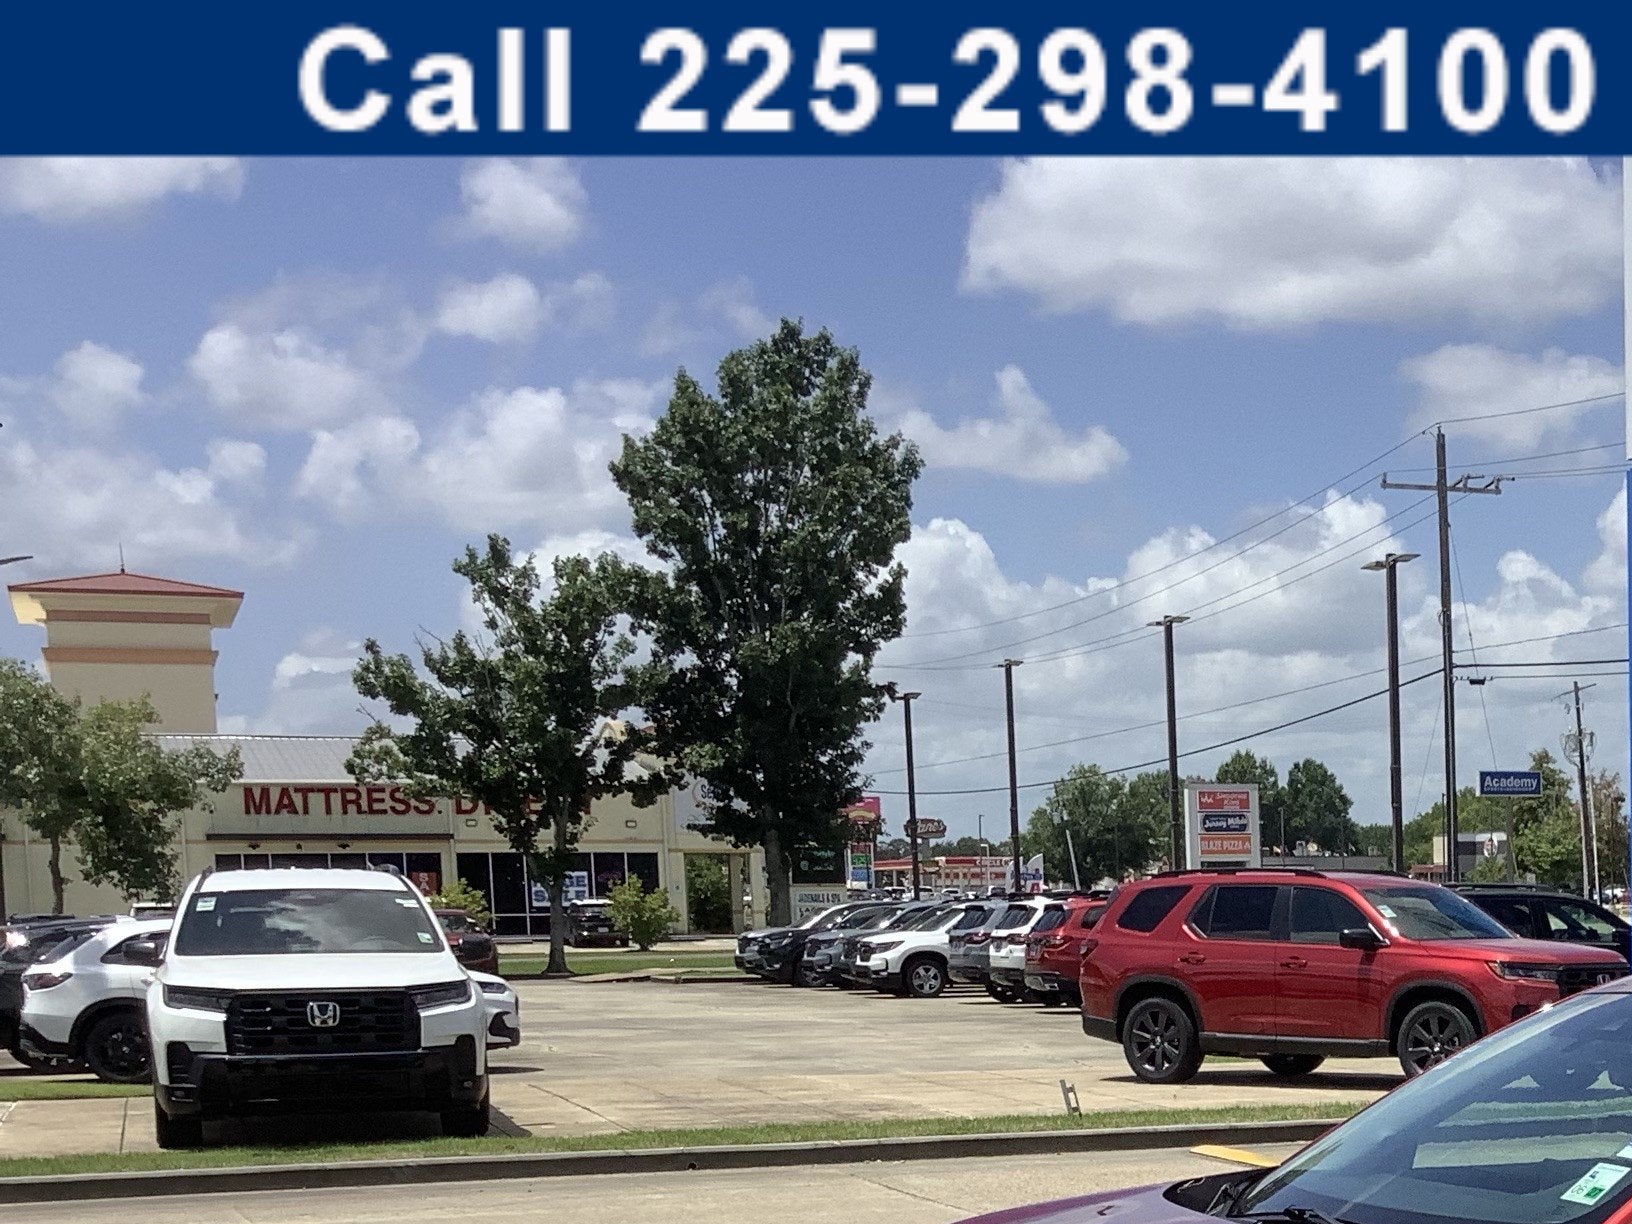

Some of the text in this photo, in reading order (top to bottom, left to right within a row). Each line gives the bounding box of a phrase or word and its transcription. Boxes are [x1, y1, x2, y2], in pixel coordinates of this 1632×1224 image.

[1484, 775, 1538, 790] Academy
[243, 786, 436, 816] MATTRESS
[1222, 841, 1243, 851] PIZZA
